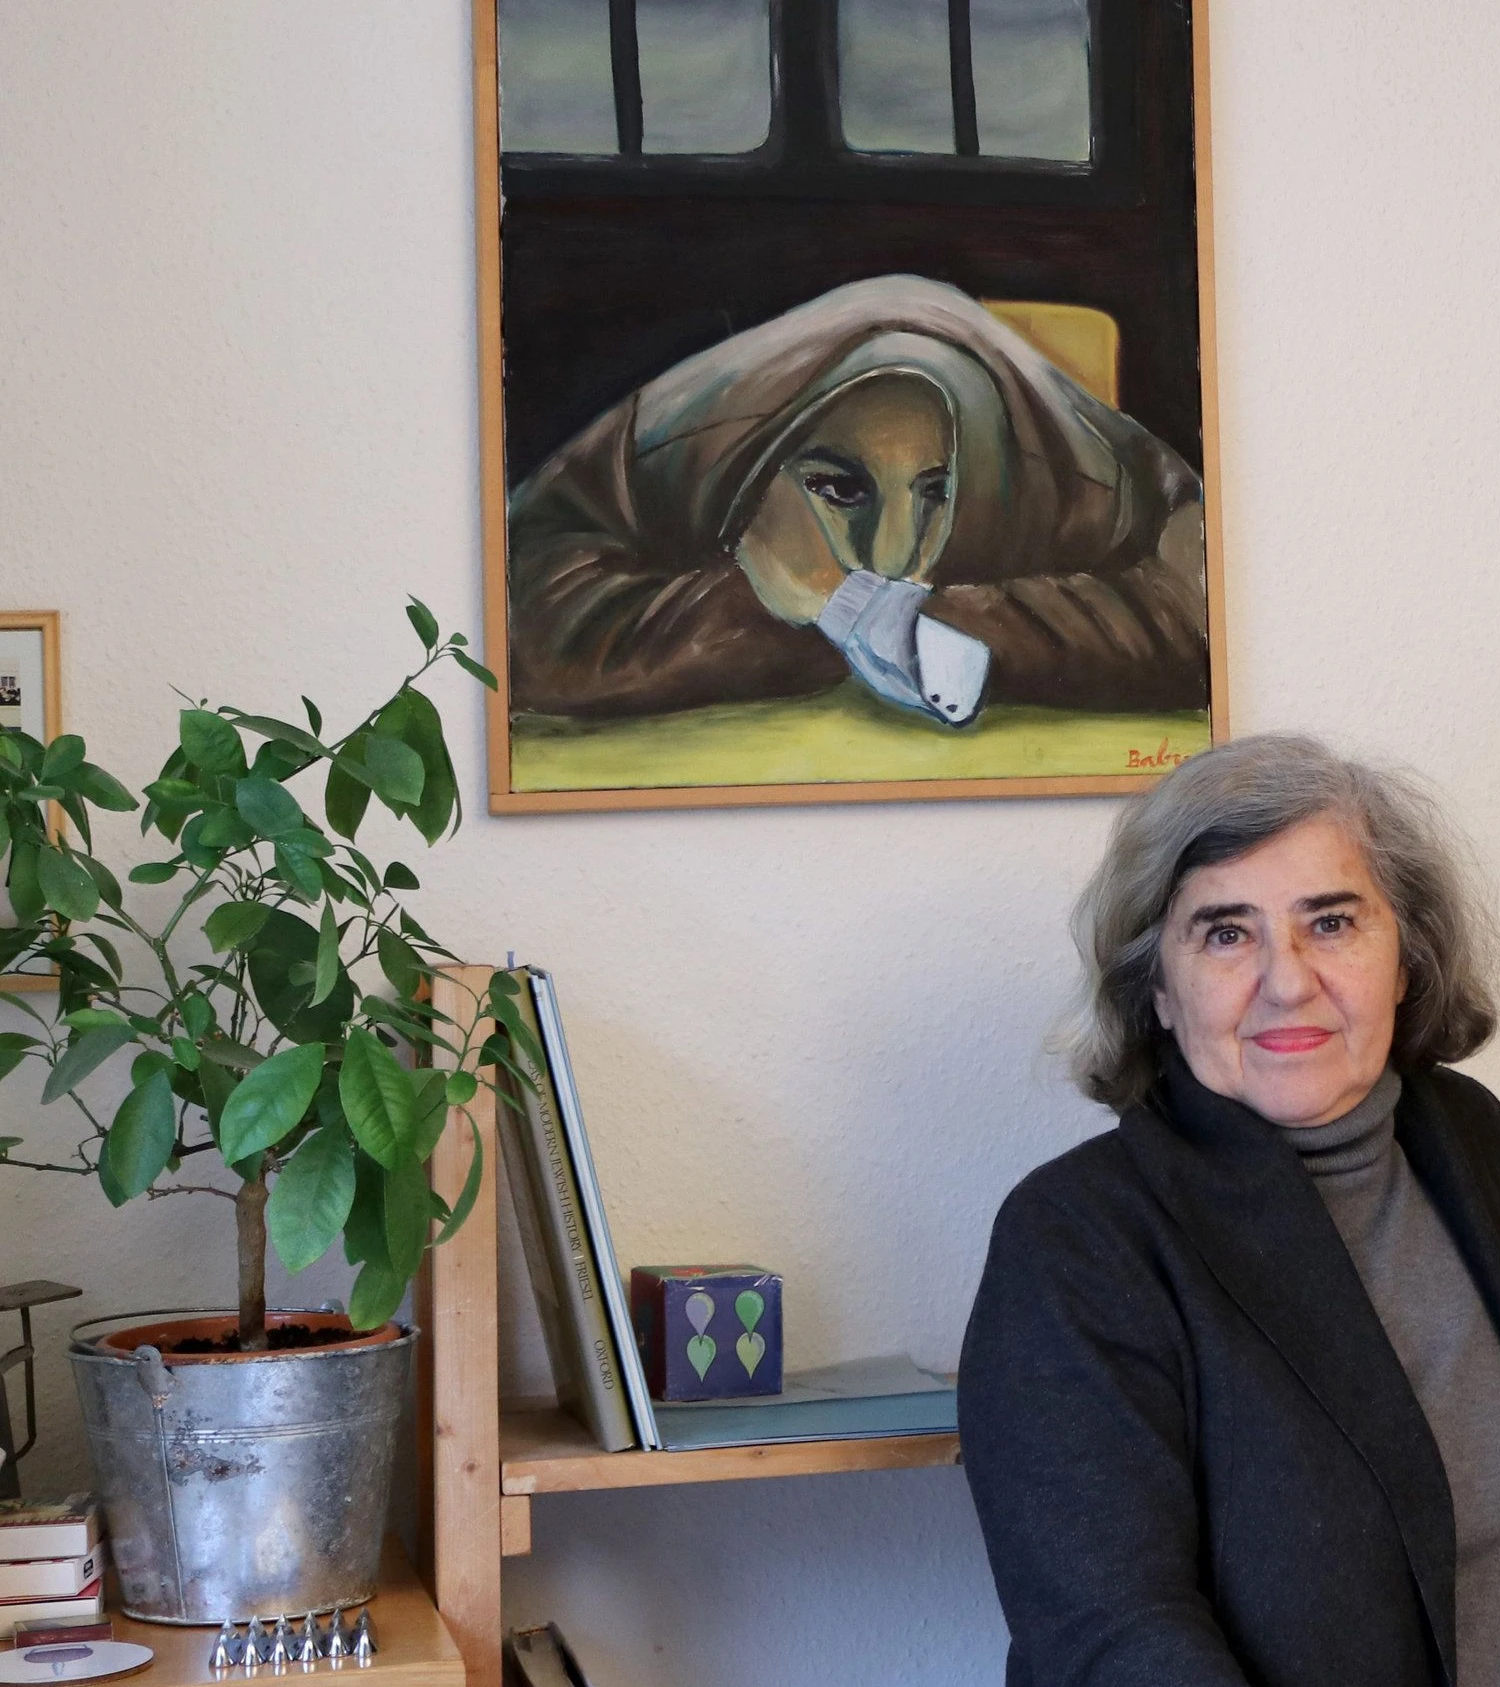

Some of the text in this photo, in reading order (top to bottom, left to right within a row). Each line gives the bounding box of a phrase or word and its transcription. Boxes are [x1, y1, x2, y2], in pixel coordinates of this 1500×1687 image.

[538, 1101, 558, 1156] MODERN
[551, 1157, 569, 1201] JEWISH
[561, 1202, 582, 1252] HISTORY
[593, 1339, 615, 1390] OXFORD
